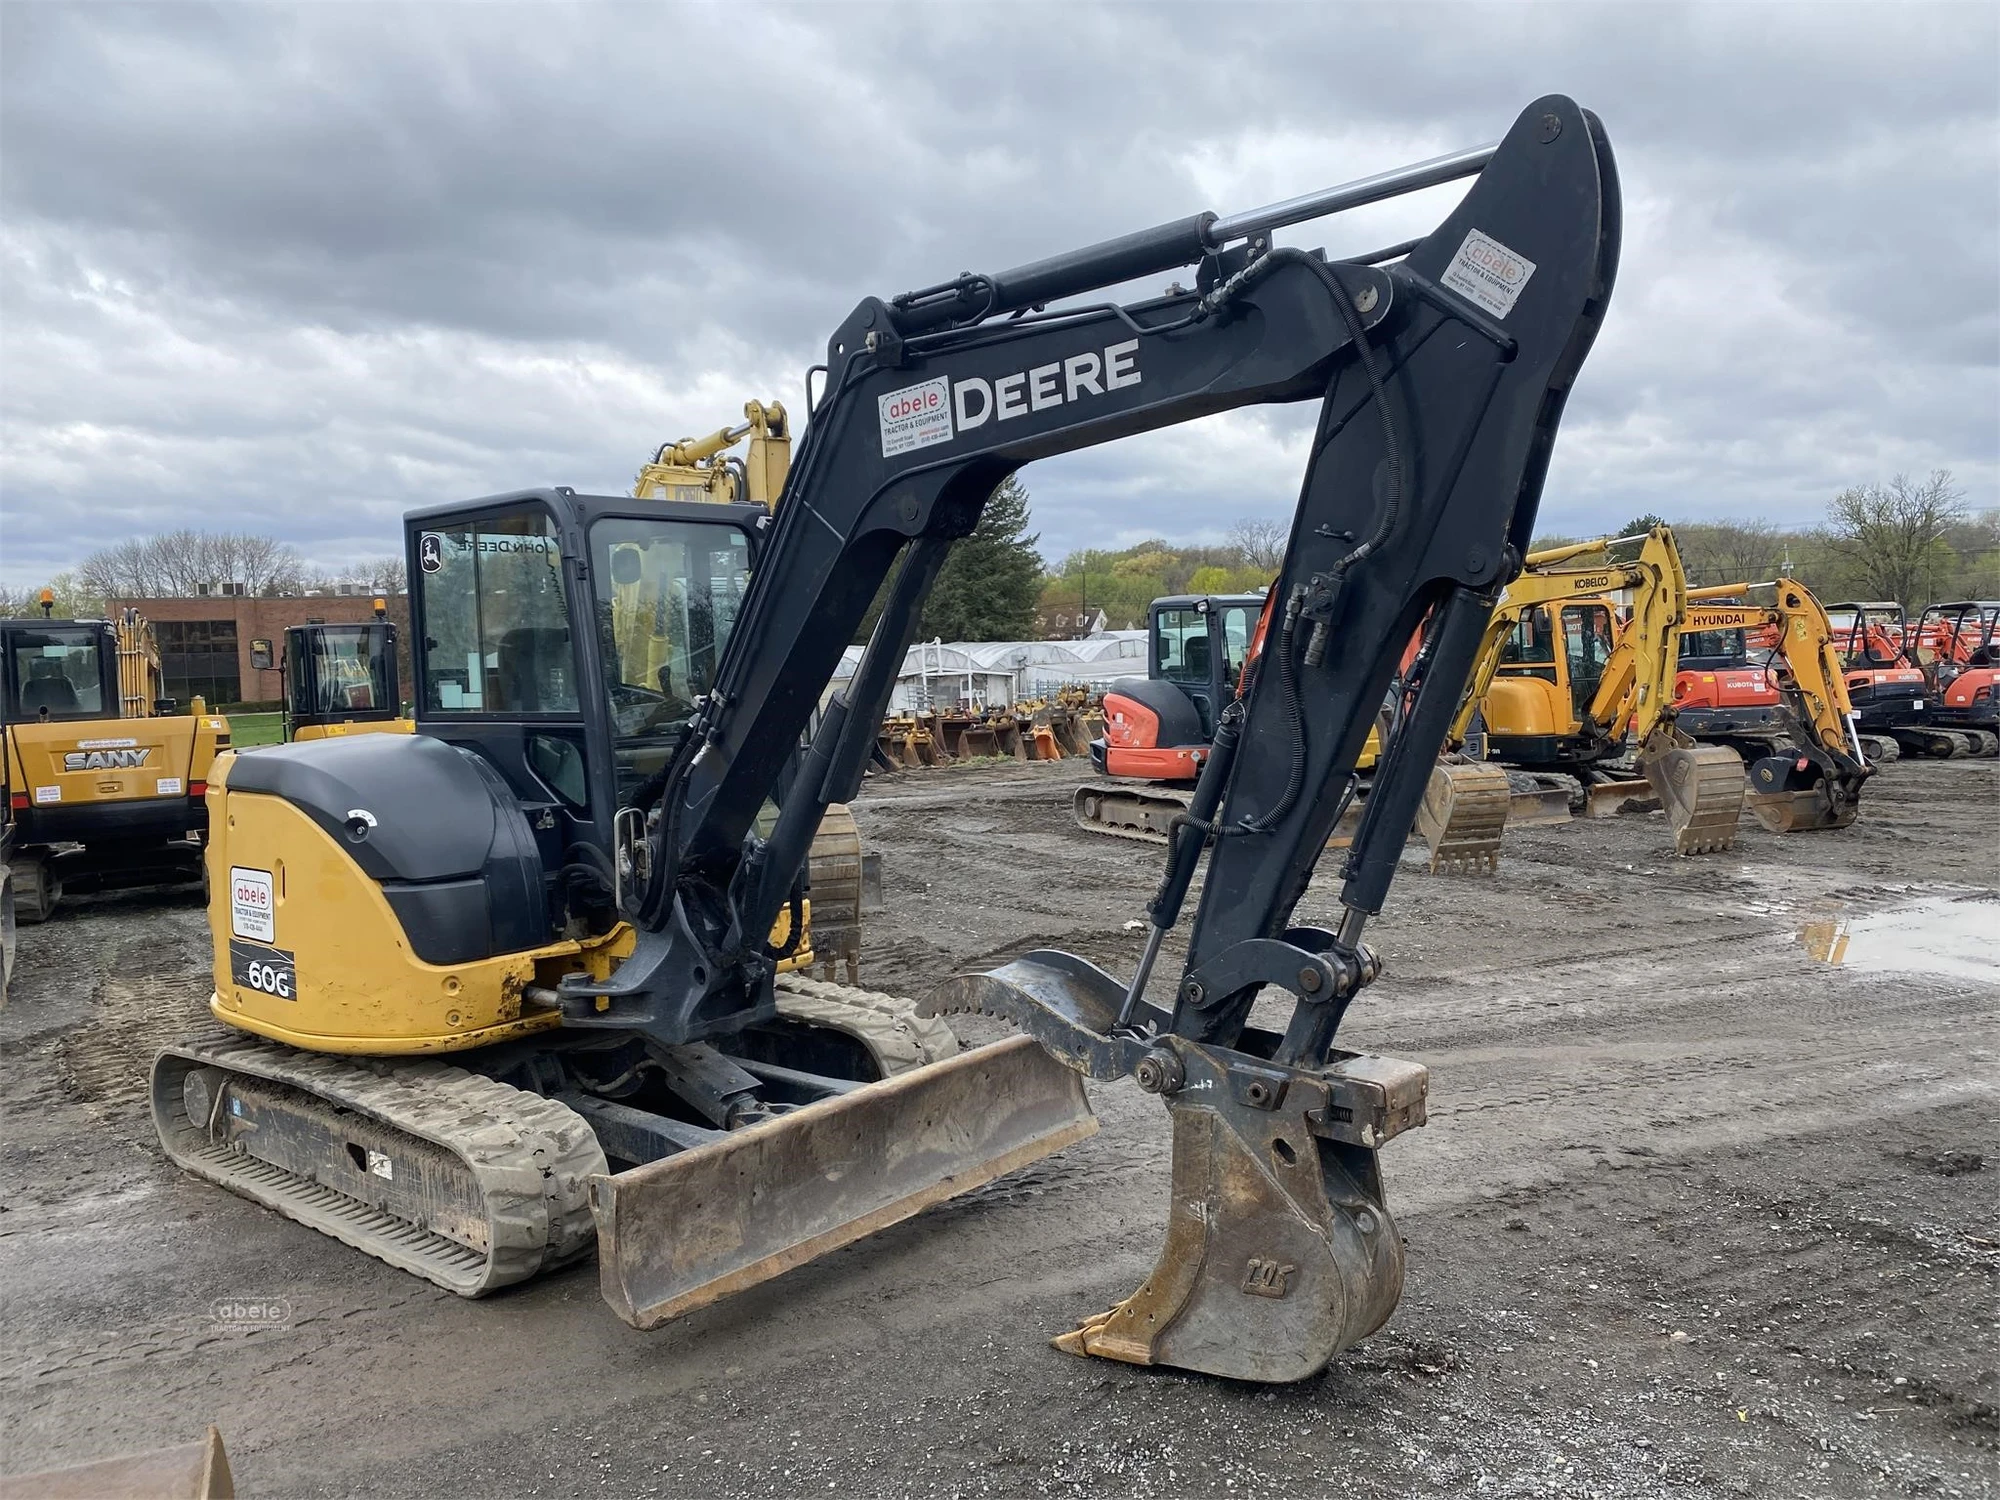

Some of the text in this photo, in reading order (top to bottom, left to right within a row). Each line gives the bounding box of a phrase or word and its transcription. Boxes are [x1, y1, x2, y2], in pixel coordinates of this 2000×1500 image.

[1471, 247, 1516, 279] abele
[1458, 259, 1482, 276] TRACTOR
[1484, 274, 1515, 296] EQUIPMENT
[953, 338, 1142, 432] DEERE
[890, 390, 938, 418] abele
[884, 423, 909, 436] TRACTOR
[909, 421, 915, 429] &
[915, 411, 948, 427] EQUIPMENT
[1574, 576, 1609, 589] KOBELCO
[1693, 614, 1746, 626] HYUNDAI
[1727, 681, 1754, 689] KUBOTA
[64, 748, 151, 772] SANY
[237, 884, 266, 904] abele
[249, 961, 289, 997] 60G
